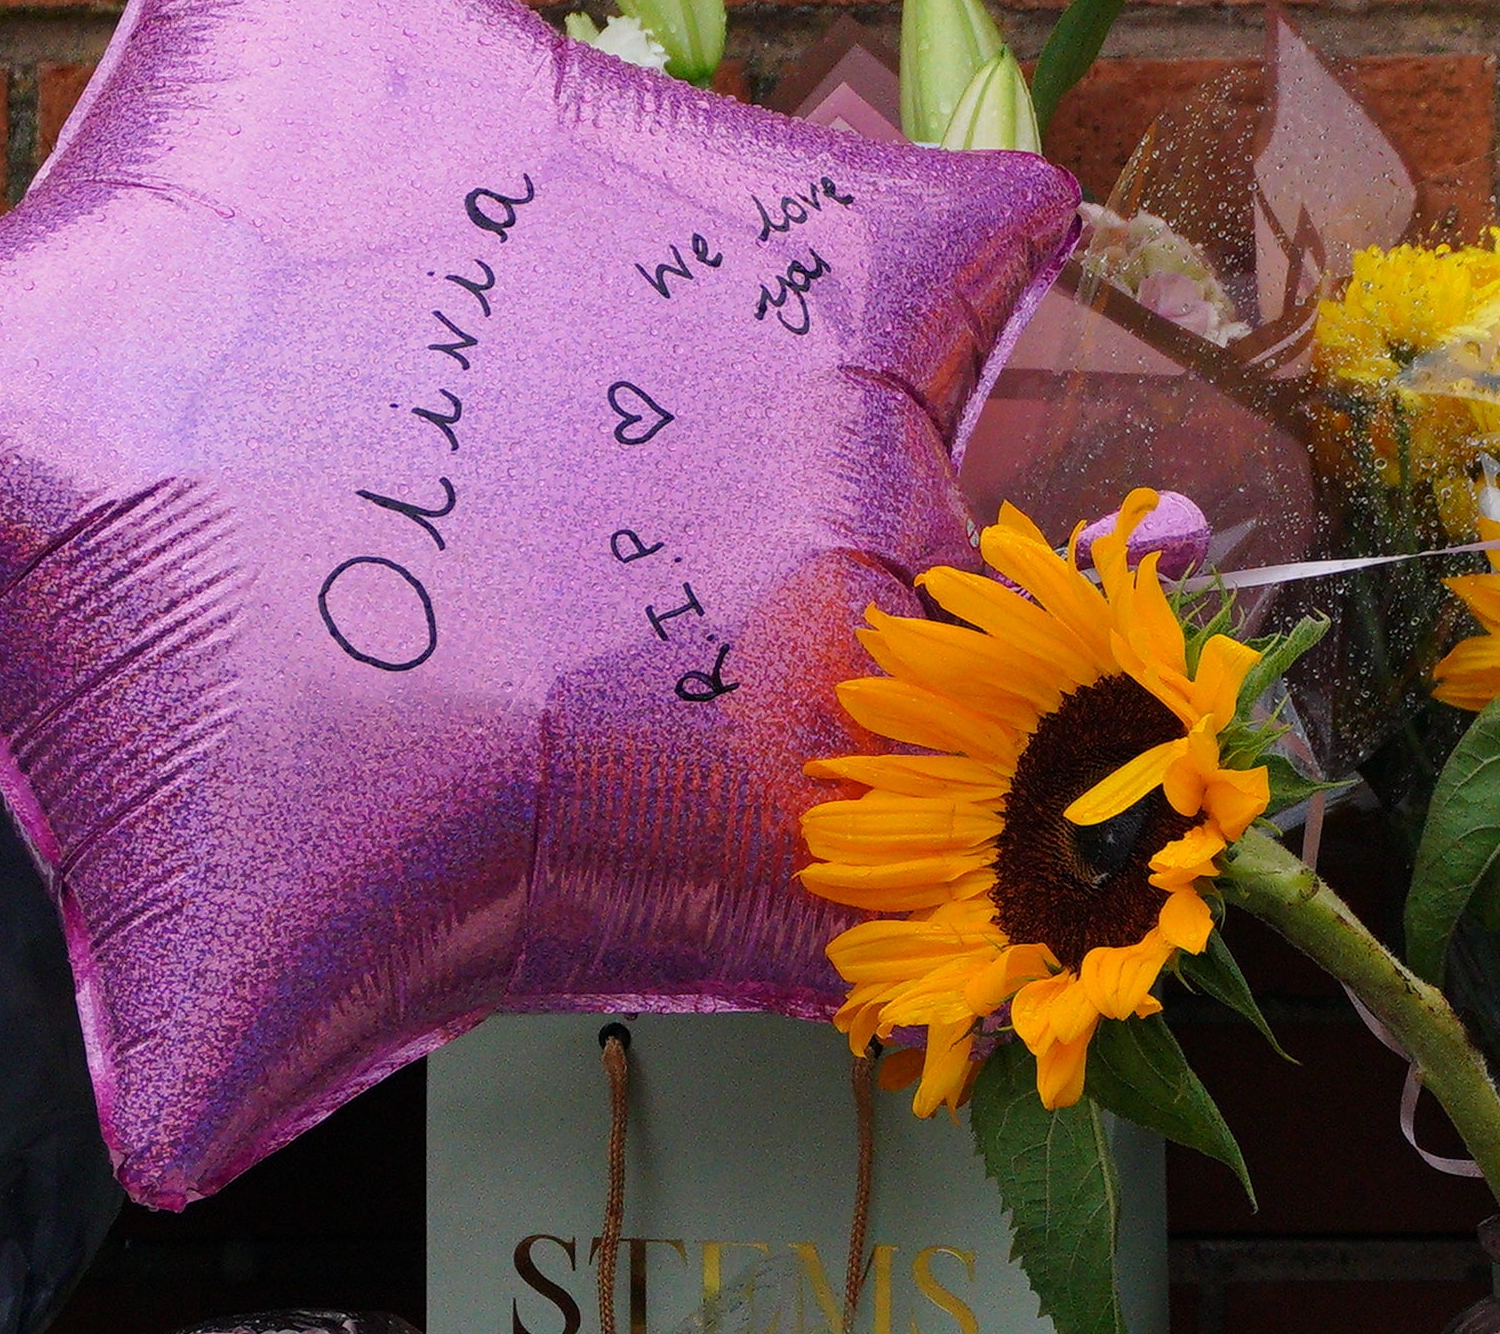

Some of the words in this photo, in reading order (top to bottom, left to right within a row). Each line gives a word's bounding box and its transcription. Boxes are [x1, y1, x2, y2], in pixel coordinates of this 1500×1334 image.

[635, 231, 725, 301] We
[755, 175, 854, 246] love
[755, 249, 830, 336] you
[318, 172, 535, 671] Olivia
